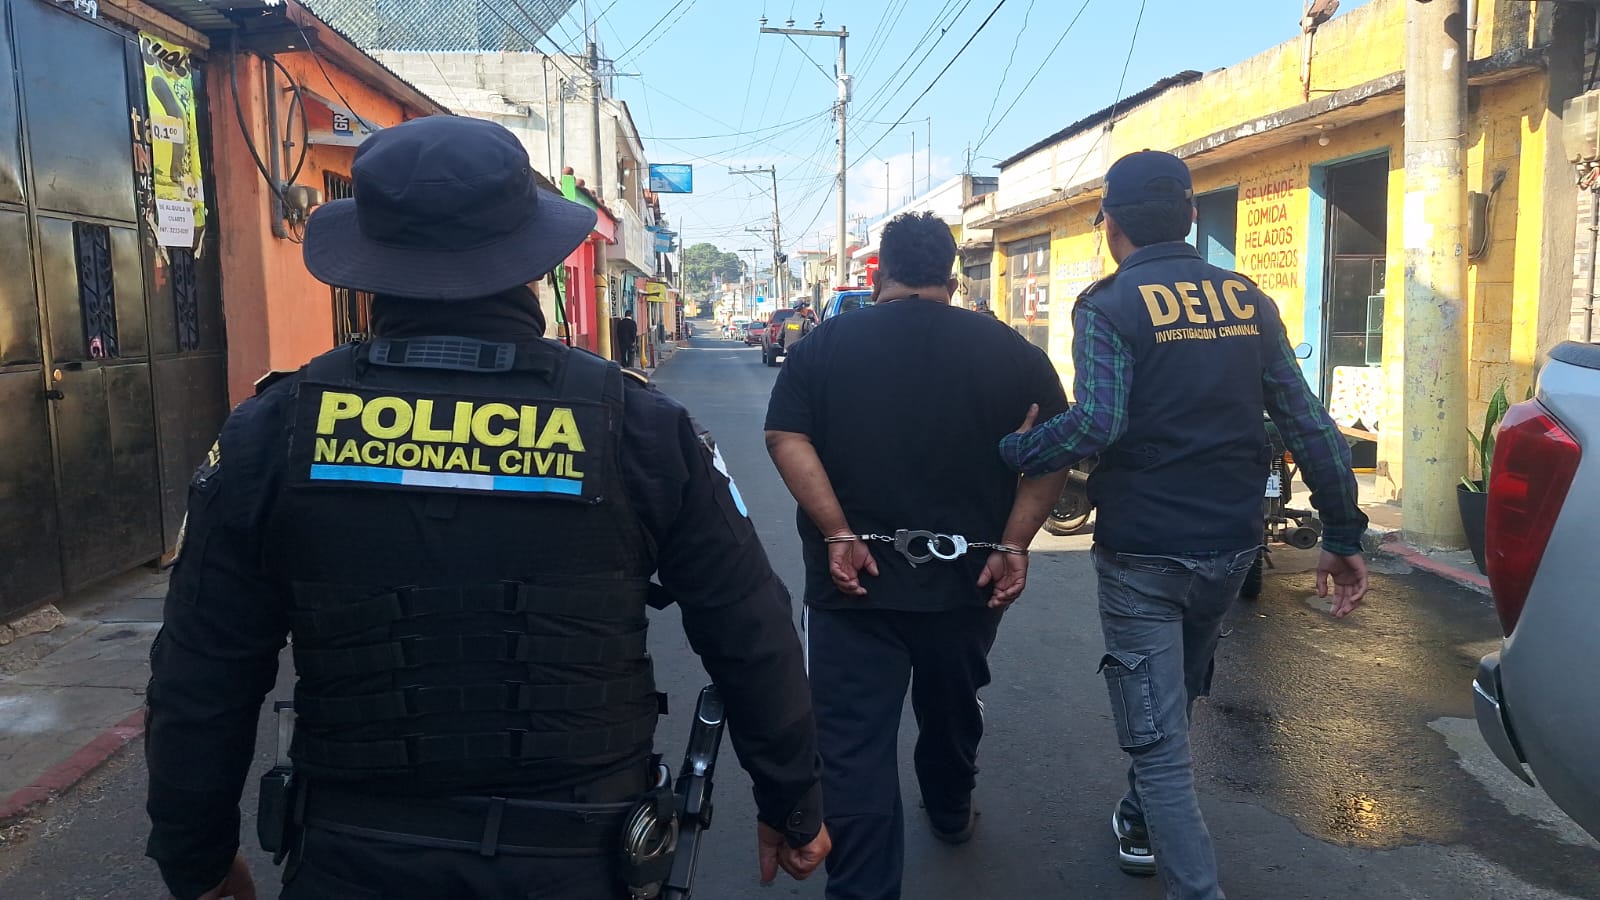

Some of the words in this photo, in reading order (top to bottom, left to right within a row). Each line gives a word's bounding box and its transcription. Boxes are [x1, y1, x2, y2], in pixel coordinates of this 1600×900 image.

[1245, 186, 1257, 205] SE
[1260, 178, 1294, 203] VENDE
[1247, 203, 1287, 227] COMIDA
[1245, 226, 1293, 249] HELADOS
[1241, 255, 1249, 269] Y
[1250, 249, 1298, 271] CHORIZOS
[1138, 279, 1255, 327] DEIC
[1219, 324, 1260, 337] CRIMINAL
[316, 391, 586, 452] POLICIA
[313, 438, 491, 473] NACIONAL
[499, 450, 585, 479] CIVIL
